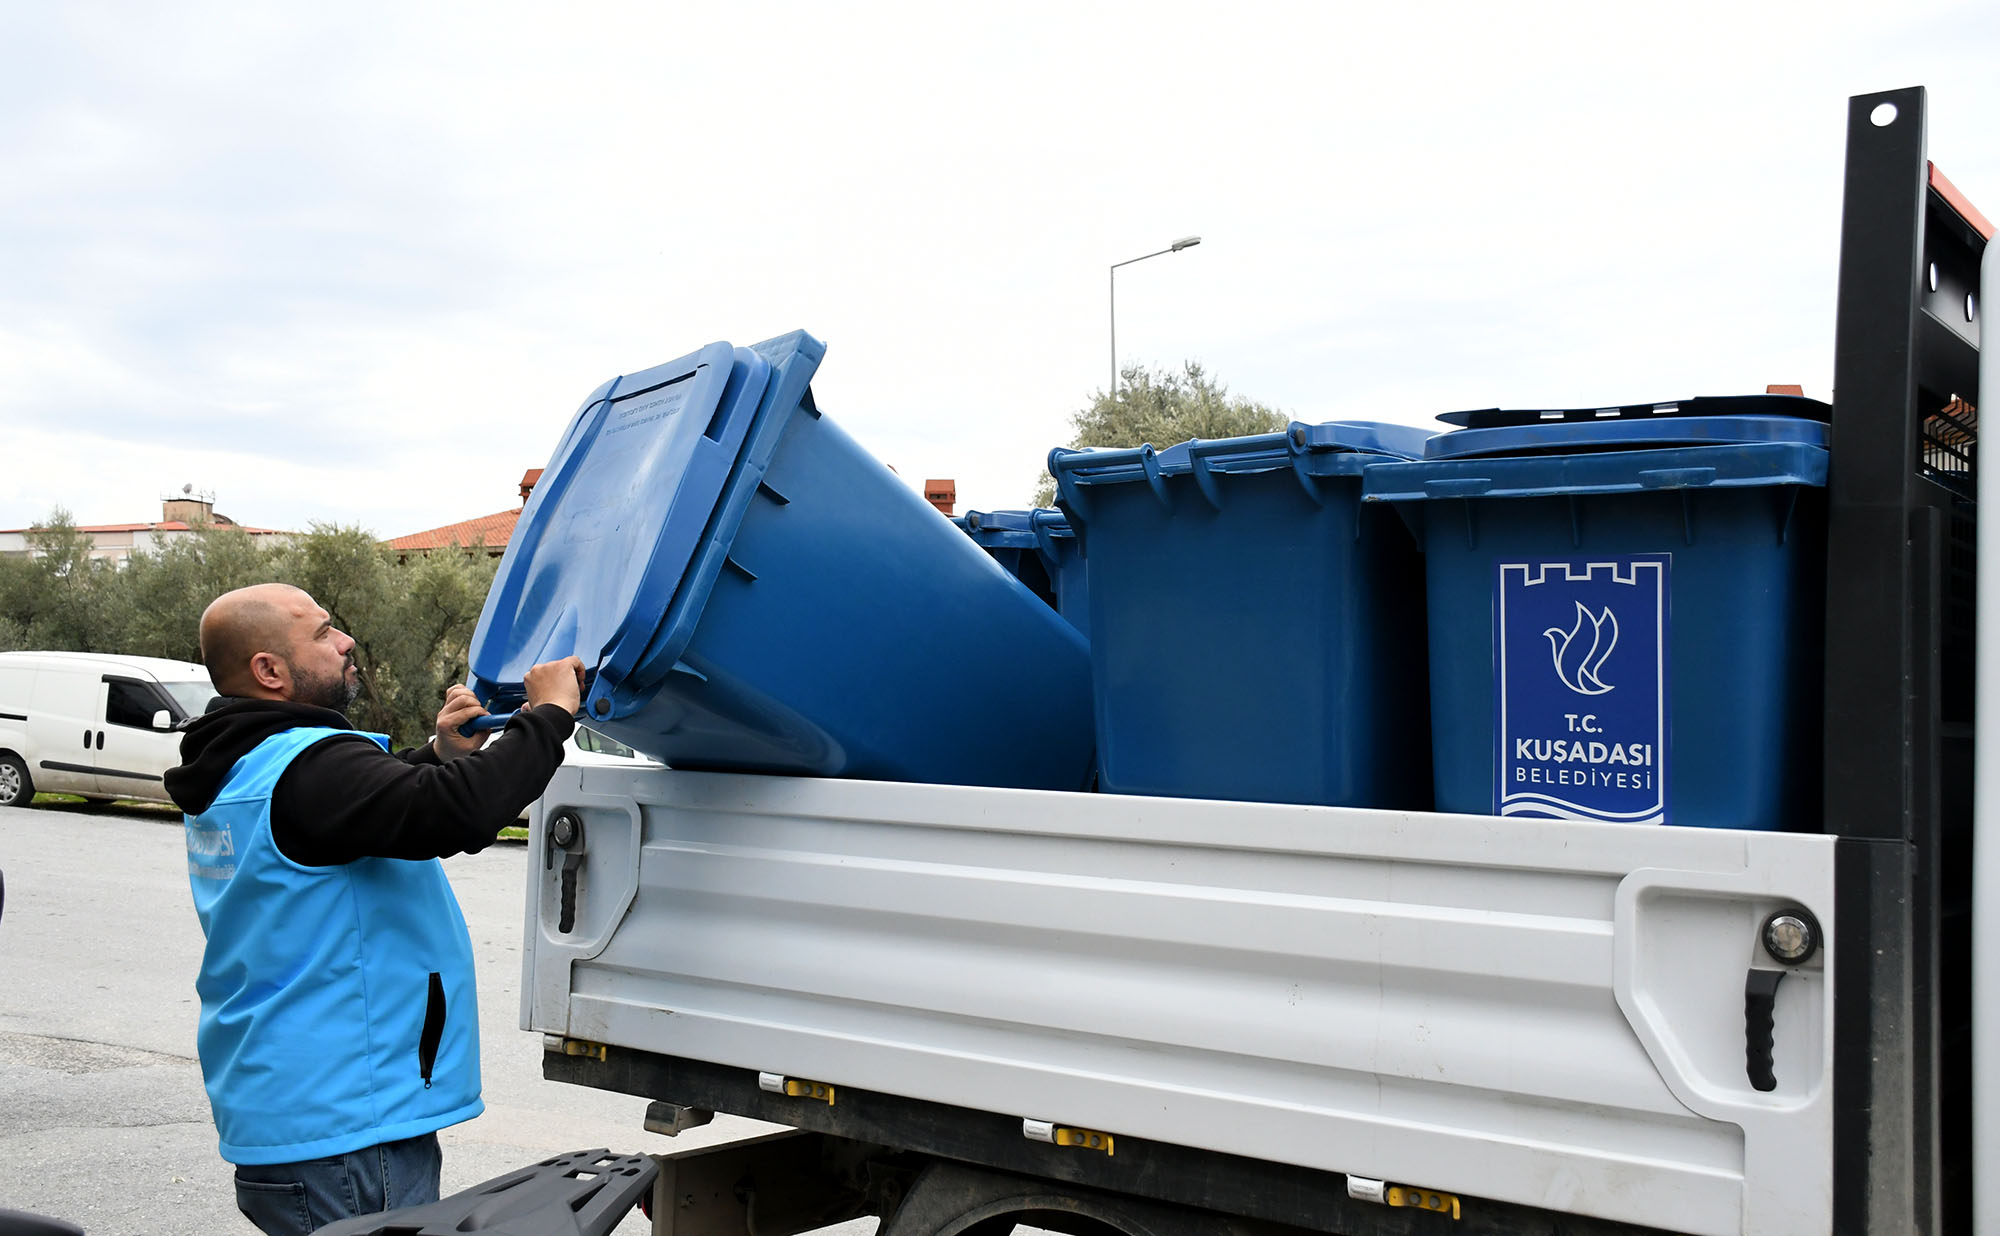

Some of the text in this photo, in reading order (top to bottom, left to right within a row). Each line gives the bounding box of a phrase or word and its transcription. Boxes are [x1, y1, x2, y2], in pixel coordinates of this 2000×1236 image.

[1564, 714, 1603, 733] T.C.
[1516, 738, 1652, 766] KUŞADASI
[1516, 767, 1651, 790] BELEDİYESİ
